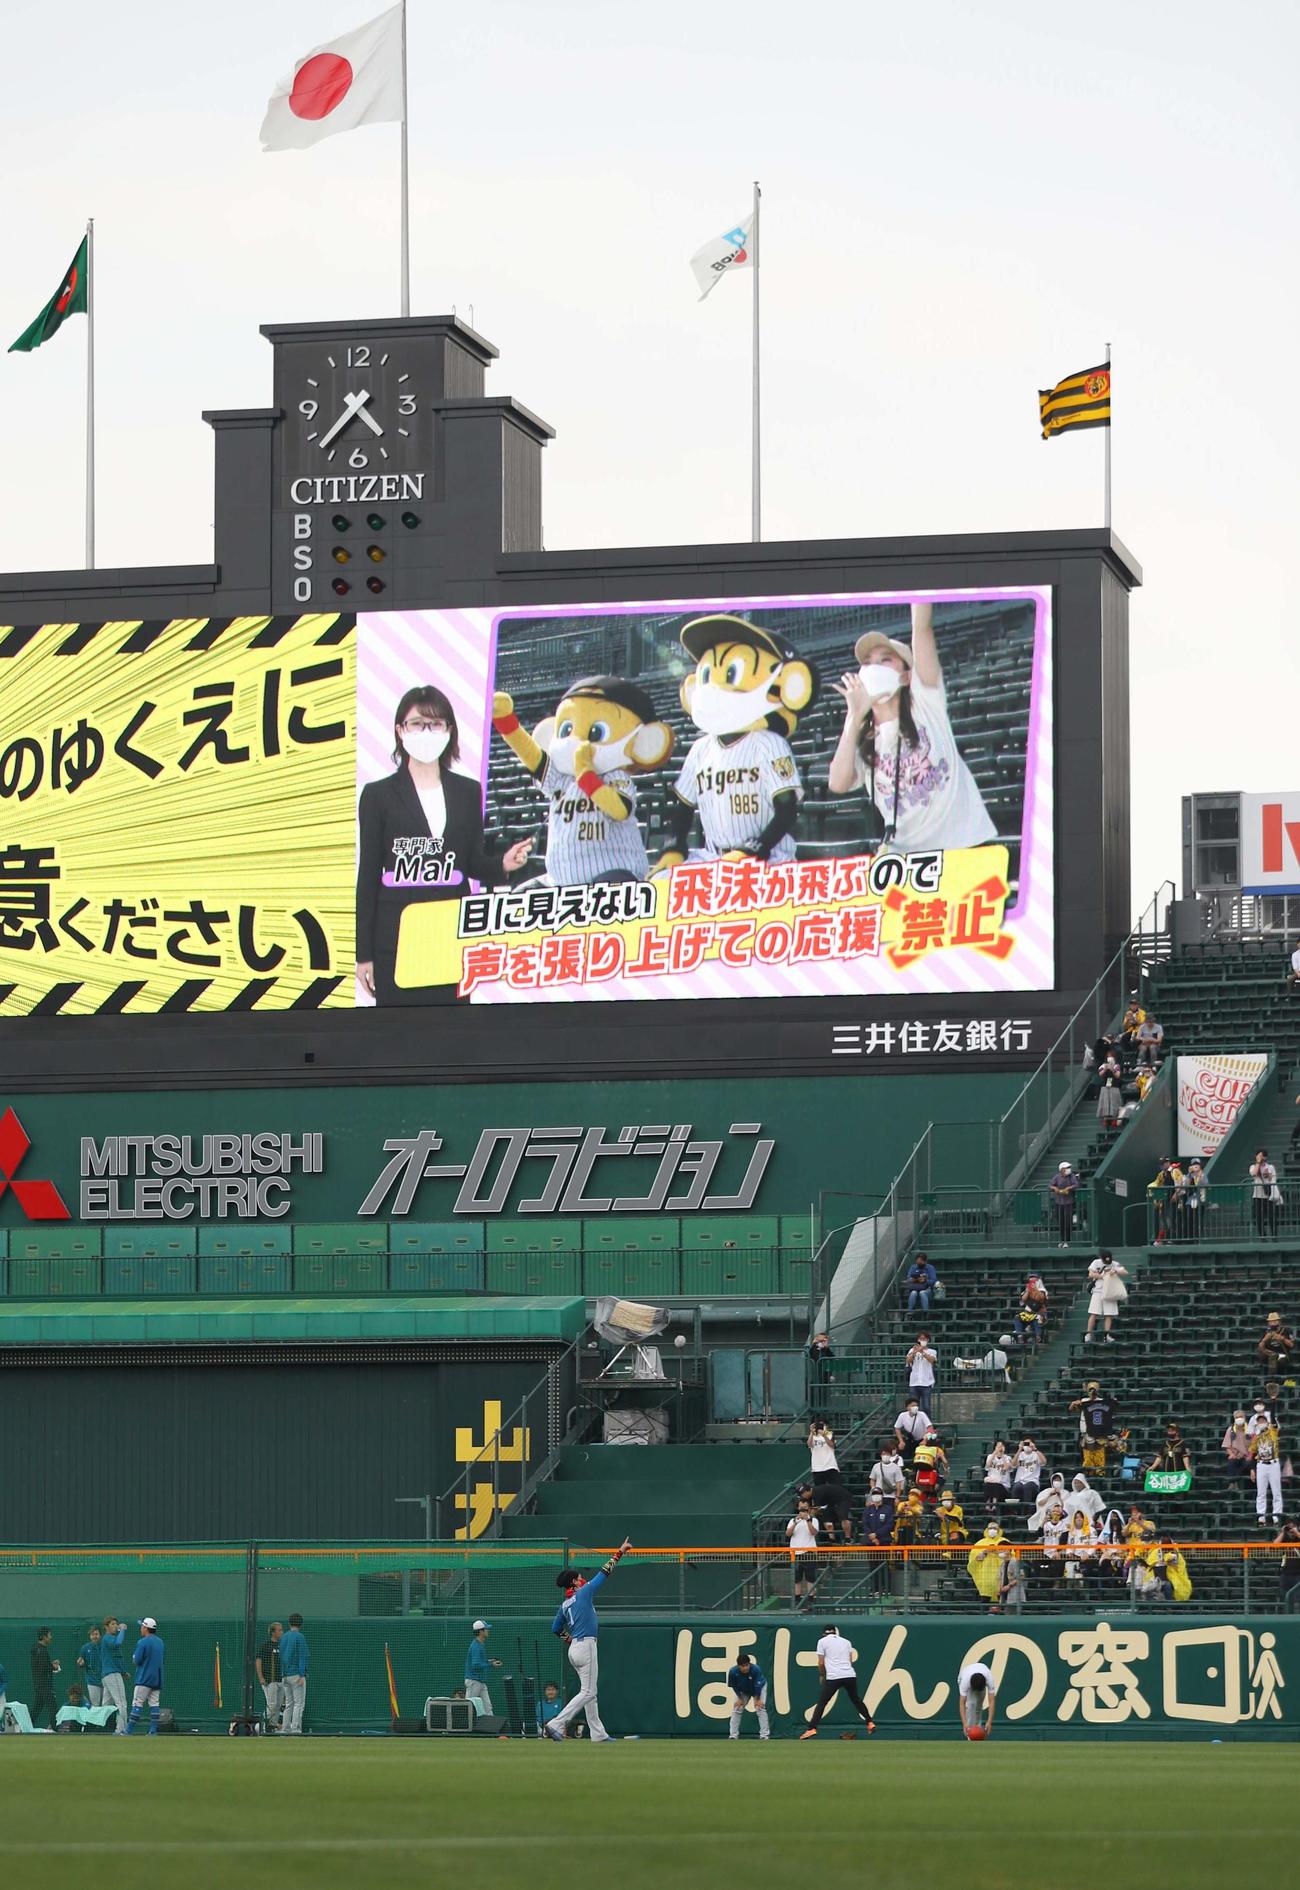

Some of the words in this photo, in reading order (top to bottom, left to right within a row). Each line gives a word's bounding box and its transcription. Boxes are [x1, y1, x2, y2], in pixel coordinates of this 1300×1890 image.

[347, 346, 370, 367] 12
[298, 400, 319, 420] 9
[398, 394, 417, 415] 3
[348, 448, 369, 468] 6
[290, 473, 425, 505] CITIZEN
[294, 514, 312, 539] B
[294, 545, 312, 570] S
[294, 577, 312, 601] O
[0, 658, 346, 802] のゆくえに
[729, 794, 759, 815] 1985
[577, 821, 606, 840] 2011
[392, 837, 444, 855] 専門家
[395, 853, 455, 884] Mai
[901, 895, 996, 951] 禁止
[832, 1020, 1032, 1054] 三井住友銀行
[80, 1132, 323, 1176] MITSUBISHI
[357, 1123, 775, 1214] オーロラビジョン
[80, 1176, 291, 1219] ELECTRIC
